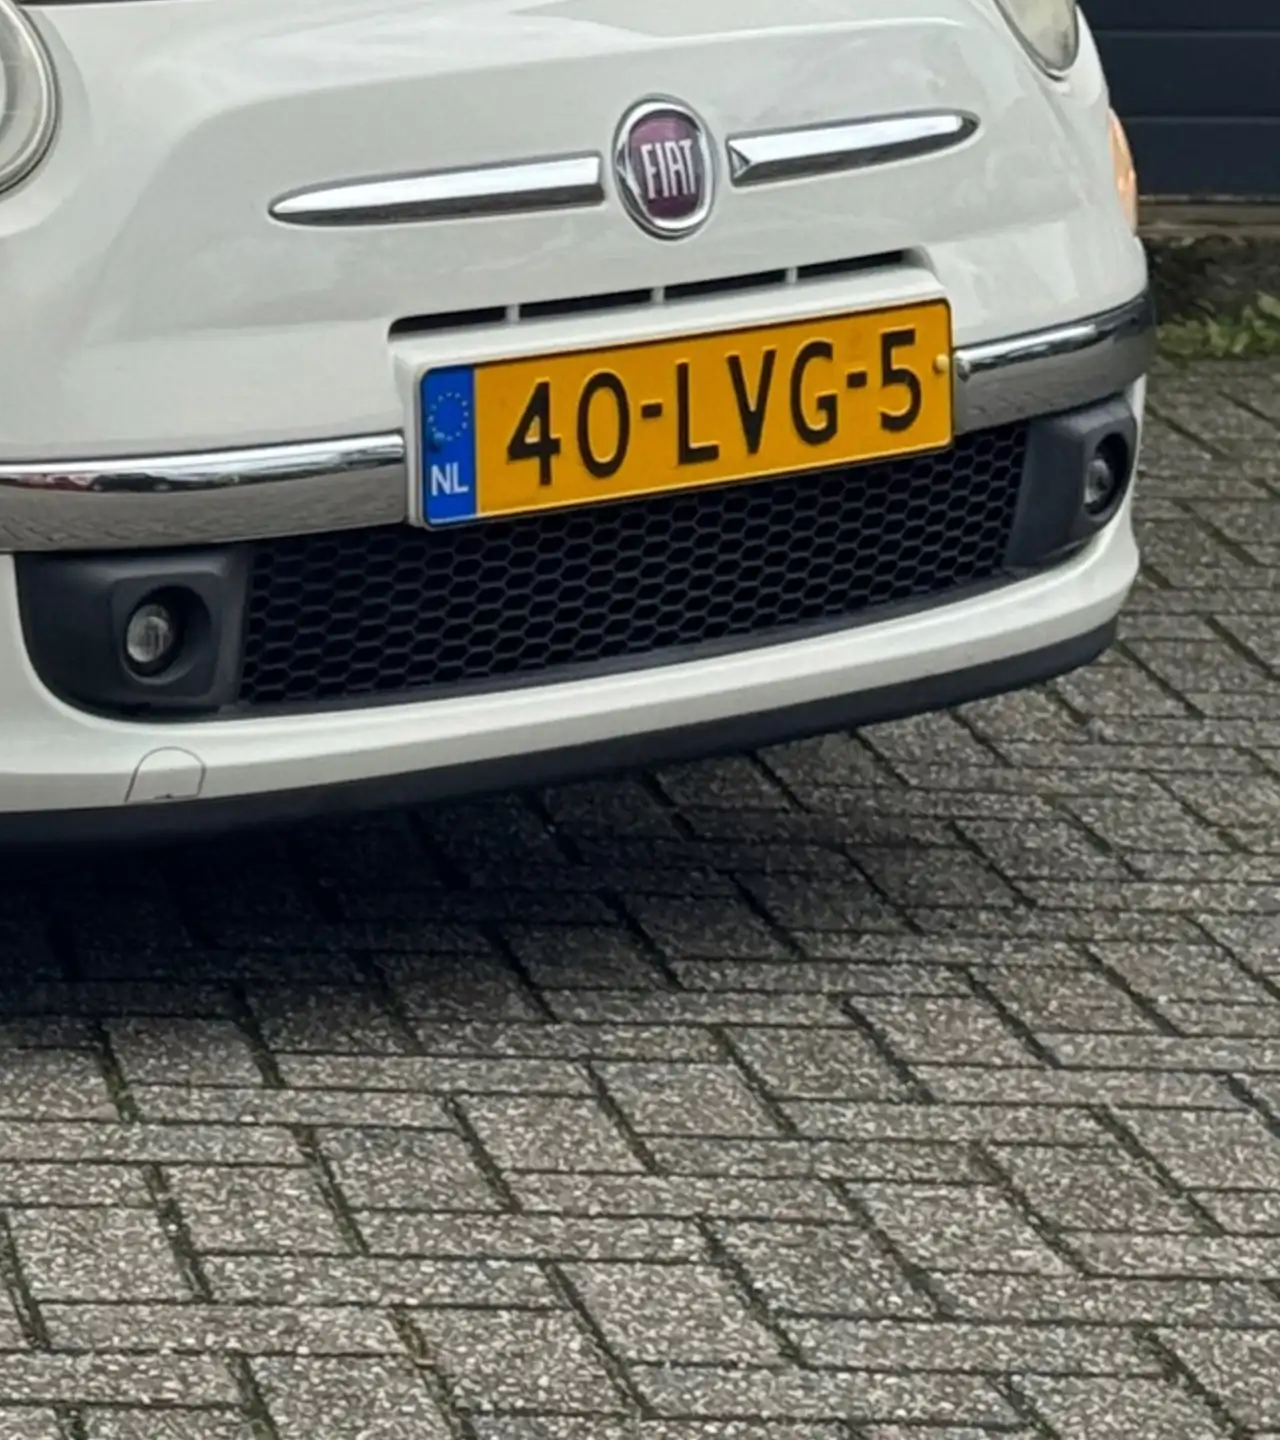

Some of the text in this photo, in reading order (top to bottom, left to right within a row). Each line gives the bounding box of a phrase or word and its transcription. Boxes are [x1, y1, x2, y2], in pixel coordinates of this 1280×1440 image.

[640, 138, 696, 200] FIAT
[506, 327, 922, 486] 40-LVG-5
[431, 461, 469, 496] NL
